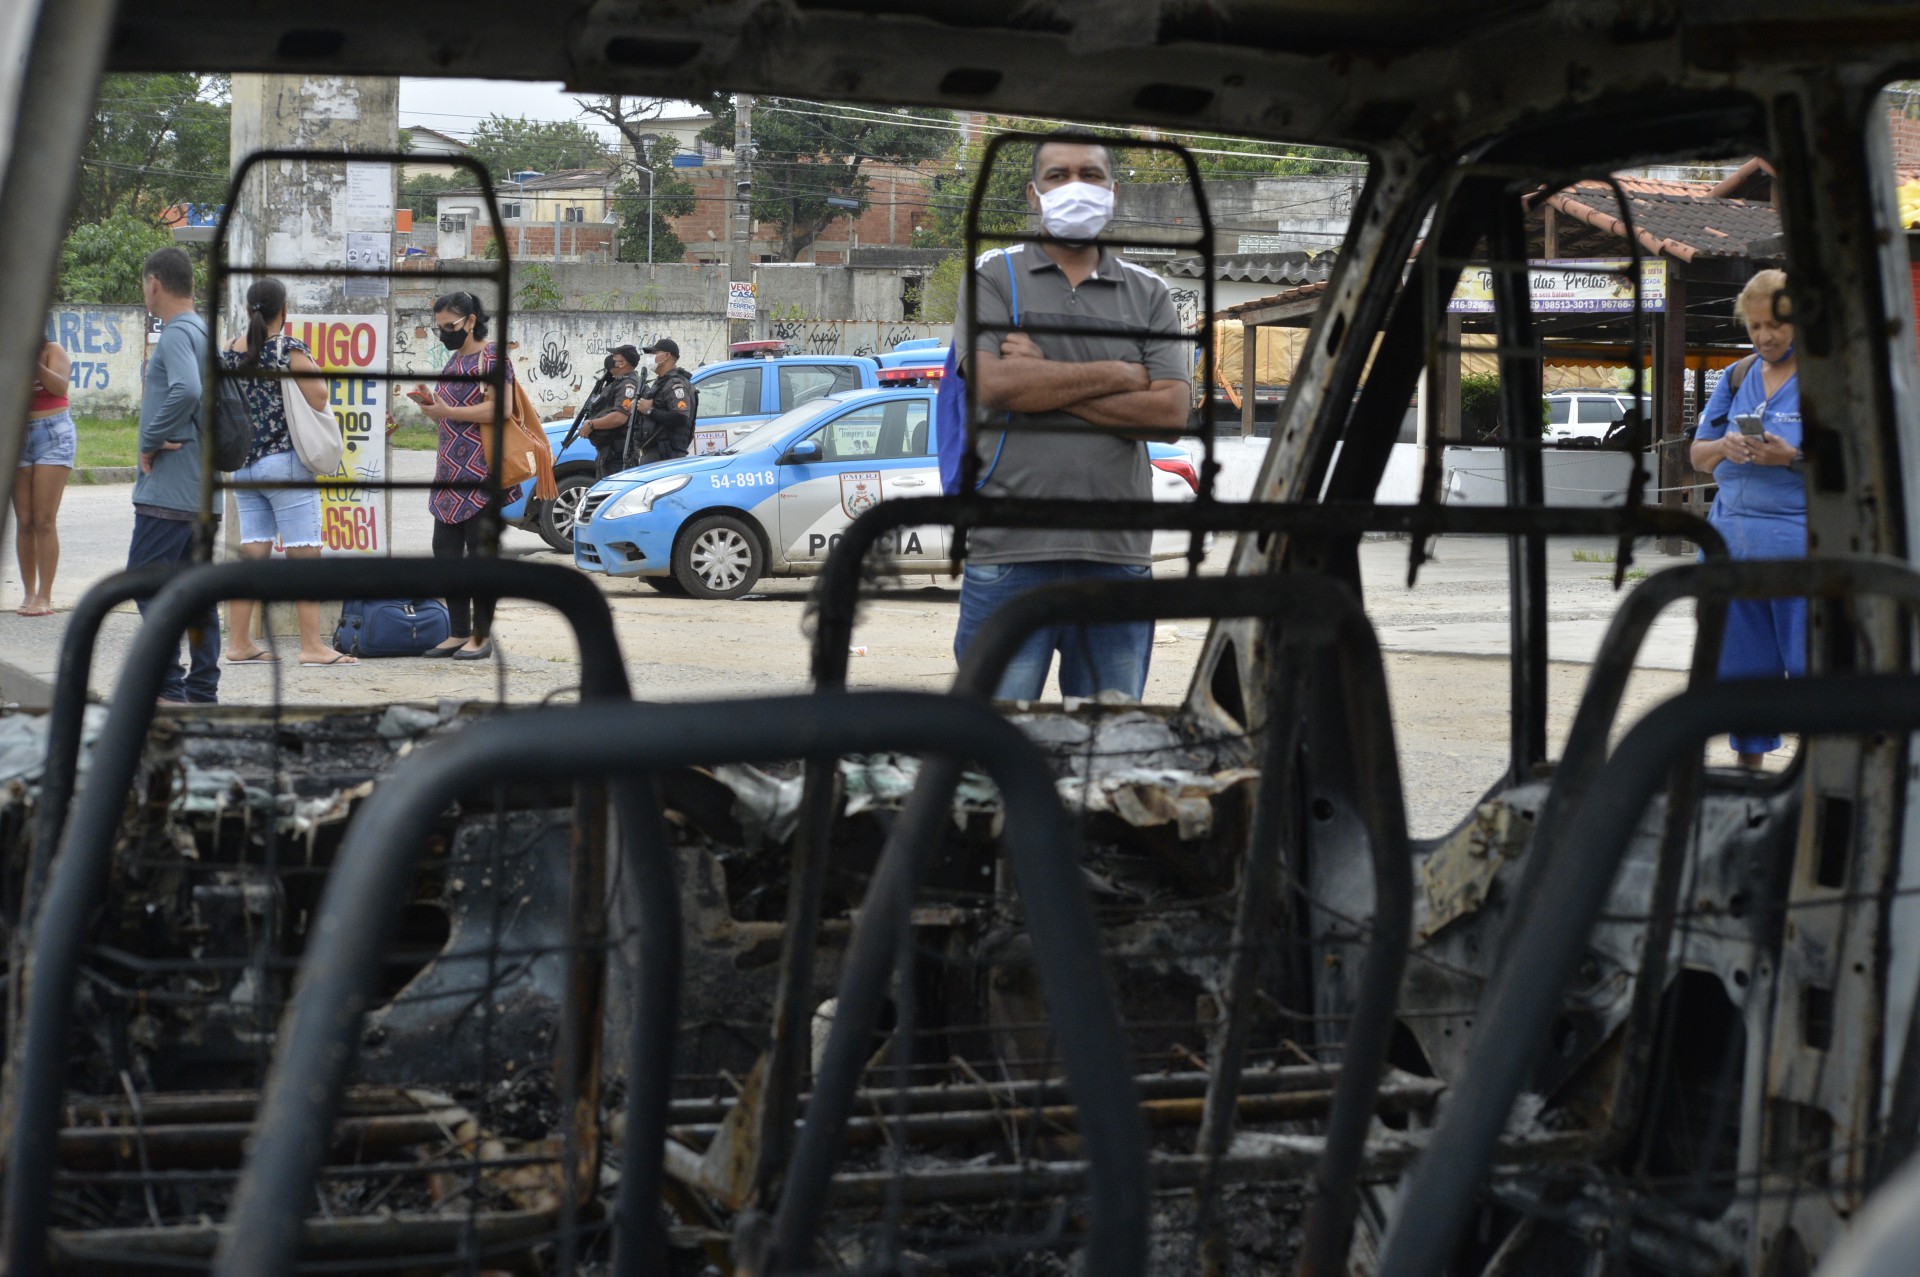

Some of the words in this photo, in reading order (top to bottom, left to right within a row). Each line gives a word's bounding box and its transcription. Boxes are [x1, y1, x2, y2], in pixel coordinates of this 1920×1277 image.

[1533, 275, 1556, 289] das
[1563, 271, 1607, 291] Pretas
[730, 283, 757, 293] VENDO
[730, 290, 755, 299] CASA
[729, 302, 756, 311] TERRENO
[1448, 300, 1489, 309] 416-9296
[710, 470, 775, 488] 54-8918
